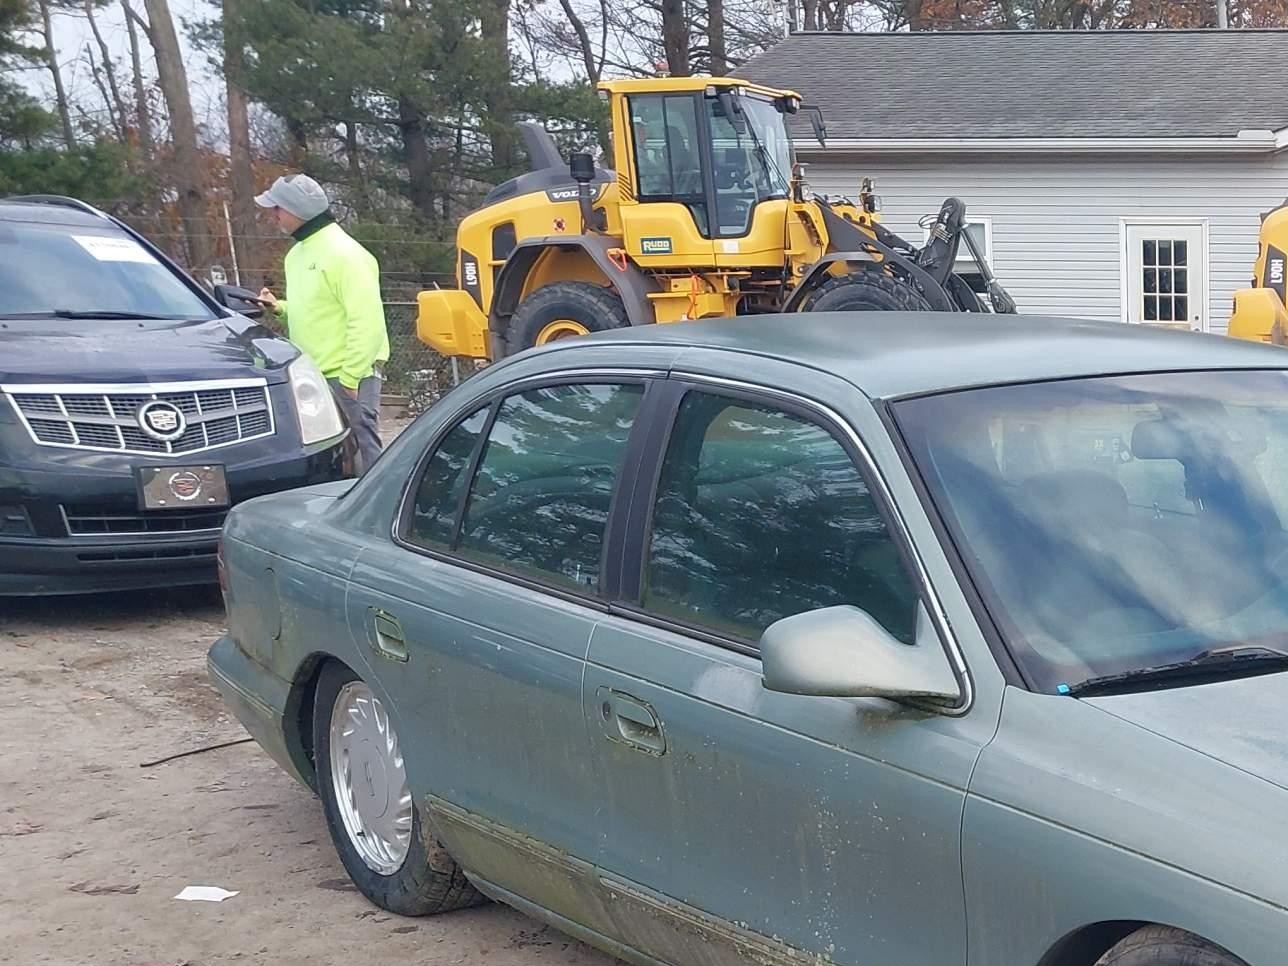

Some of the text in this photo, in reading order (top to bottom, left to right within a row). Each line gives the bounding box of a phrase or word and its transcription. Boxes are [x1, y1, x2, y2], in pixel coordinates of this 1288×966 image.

[551, 188, 597, 199] VOLO
[464, 262, 478, 286] L90H
[1270, 259, 1284, 284] L90H
